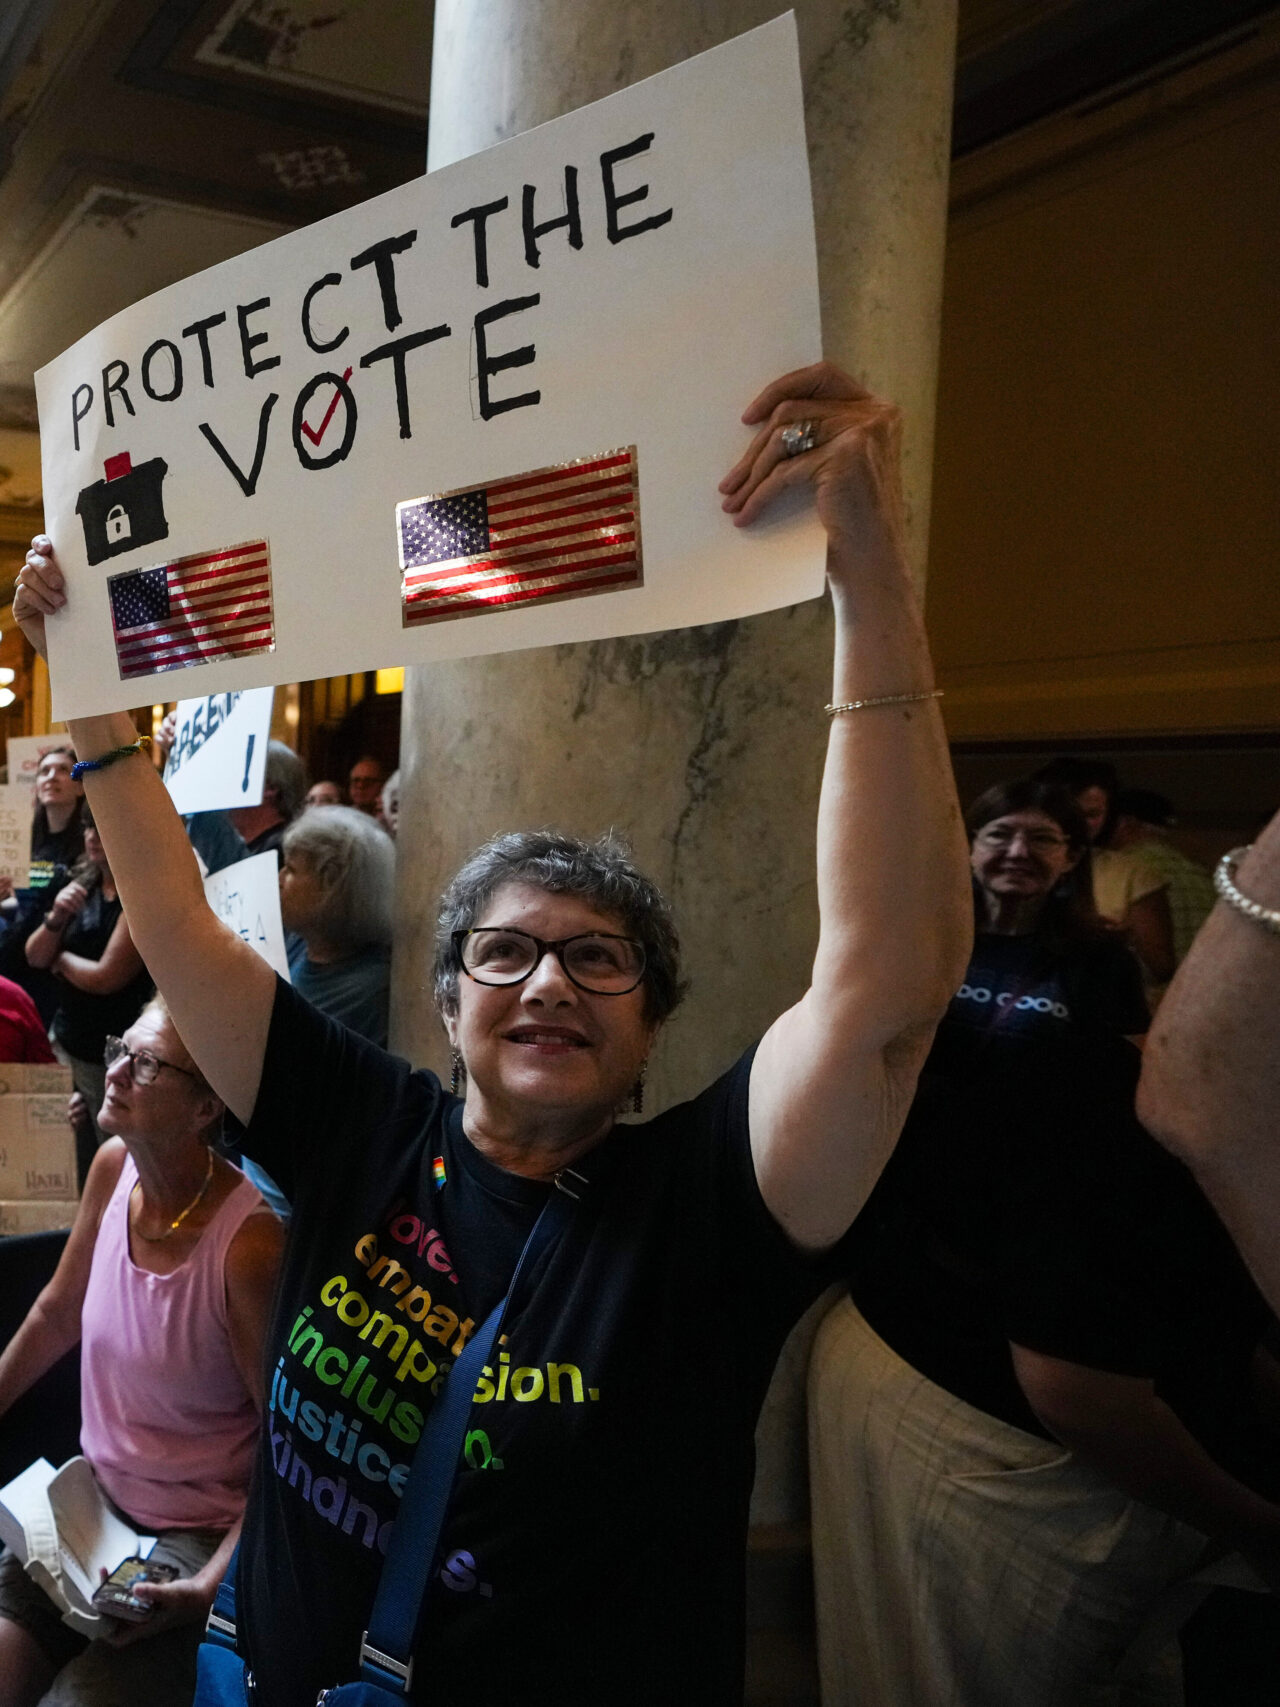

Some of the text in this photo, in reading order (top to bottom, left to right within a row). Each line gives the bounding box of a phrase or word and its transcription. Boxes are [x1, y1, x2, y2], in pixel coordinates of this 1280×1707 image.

[70, 132, 673, 451] PROTECT THE
[198, 292, 541, 498] VOTE
[388, 1212, 460, 1285] ove.
[286, 1305, 505, 1472] inclusn.
[319, 1273, 601, 1405] compsion.
